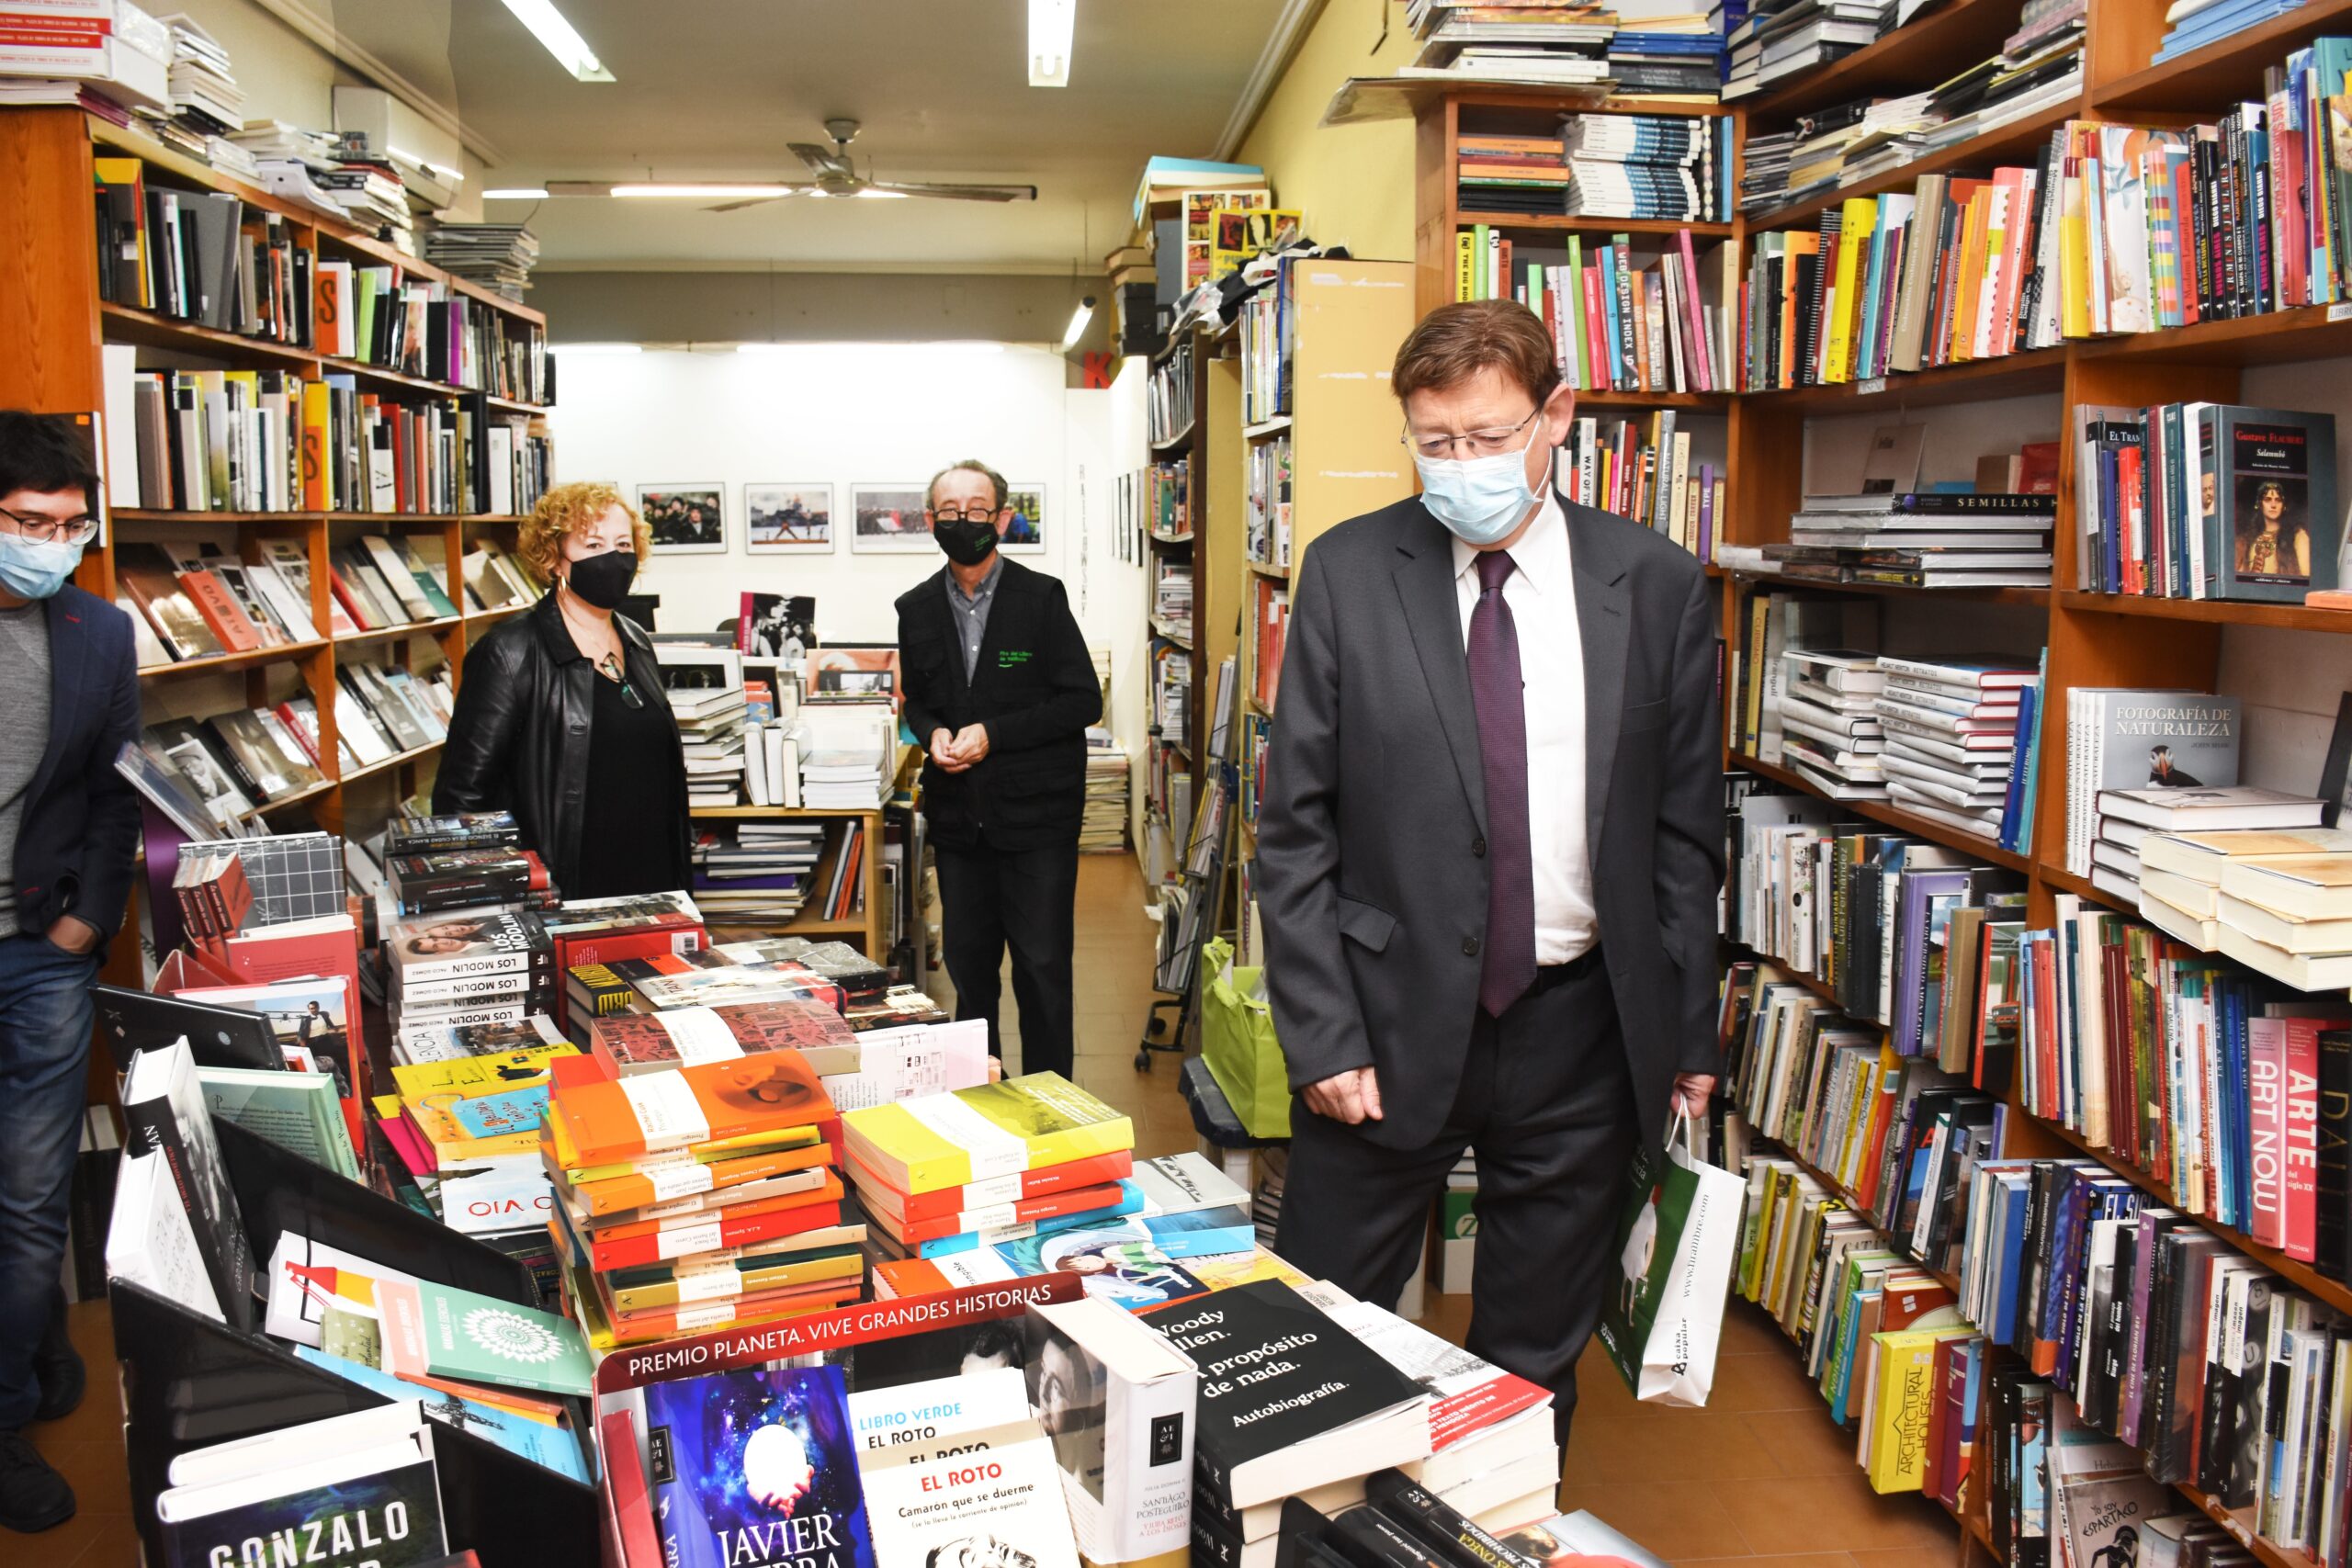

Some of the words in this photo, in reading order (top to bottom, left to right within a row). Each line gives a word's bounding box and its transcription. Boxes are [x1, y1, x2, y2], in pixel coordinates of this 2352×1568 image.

[1617, 252, 1627, 273] WEB
[1619, 276, 1631, 314] DESIGN
[1623, 319, 1633, 350] INDEX
[1084, 351, 1111, 389] K
[2235, 432, 2267, 443] Gustave
[1583, 456, 1591, 476] WAY
[1662, 452, 1671, 488] NATURAL
[1584, 479, 1591, 489] OF
[1657, 489, 1668, 521] LIGHT
[1702, 487, 1711, 509] TYPE
[1957, 497, 2041, 508] SEMILLAS
[2116, 706, 2207, 720] FOTOGRAFÍA
[2211, 709, 2231, 720] DE
[2116, 722, 2231, 736] NATURALEZA
[1838, 847, 1848, 914] Fernández
[491, 933, 513, 952] LOS
[498, 914, 531, 950] MODLIN
[453, 961, 494, 973] MODLIN
[498, 958, 516, 968] LOS
[453, 982, 494, 993] MODLIN
[498, 979, 517, 989] LOS
[454, 995, 495, 1007] MODLIN
[499, 993, 517, 1002] LOS
[448, 1013, 491, 1025] MODLIN
[493, 1011, 513, 1021] LOS
[2252, 1060, 2278, 1125] ART
[2287, 1069, 2317, 1168] ARTE
[2252, 1133, 2278, 1213] NOW
[2287, 1169, 2298, 1179] del
[2302, 1181, 2314, 1191] XX
[469, 1199, 524, 1216] VIO
[746, 1277, 768, 1286] Kennedy
[770, 1274, 788, 1282] William
[2115, 1301, 2123, 1321] hombre
[628, 1347, 708, 1376] PREMIO
[713, 1328, 805, 1363] PLANETA.
[808, 1317, 853, 1340] VIVE
[859, 1303, 950, 1332] GRANDES
[956, 1284, 1051, 1318] HISTORIAS
[1178, 1330, 1232, 1352] llen.
[1209, 1330, 1317, 1377] propósito
[1204, 1379, 1233, 1399] de
[1237, 1360, 1301, 1391] nada.
[1231, 1382, 1350, 1428] Autobiografía.
[859, 1410, 907, 1431] LIBRO
[911, 1403, 962, 1422] VERDE
[1900, 1366, 1924, 1475] ARCHITECTURAL
[1917, 1390, 1931, 1449] HOUSES
[868, 1435, 886, 1450] EL
[891, 1427, 936, 1446] ROTO
[922, 1476, 944, 1493] EL
[948, 1462, 1002, 1486] ROTO
[898, 1500, 948, 1518] Camarón
[952, 1496, 972, 1511] que
[977, 1492, 990, 1503] se
[993, 1481, 1035, 1499] duerme
[1142, 1491, 1186, 1507] SANTIAGO
[933, 1517, 948, 1526] lleva
[958, 1509, 987, 1521] corriente
[2083, 1501, 2139, 1537] ESPARTACO
[209, 1501, 409, 1568] GONZALO
[718, 1513, 842, 1568] JAVIER
[1147, 1529, 1160, 1537] LOS
[1458, 1518, 1521, 1565] PROHIBIDOS
[1457, 1532, 1496, 1562] ÓNEGA
